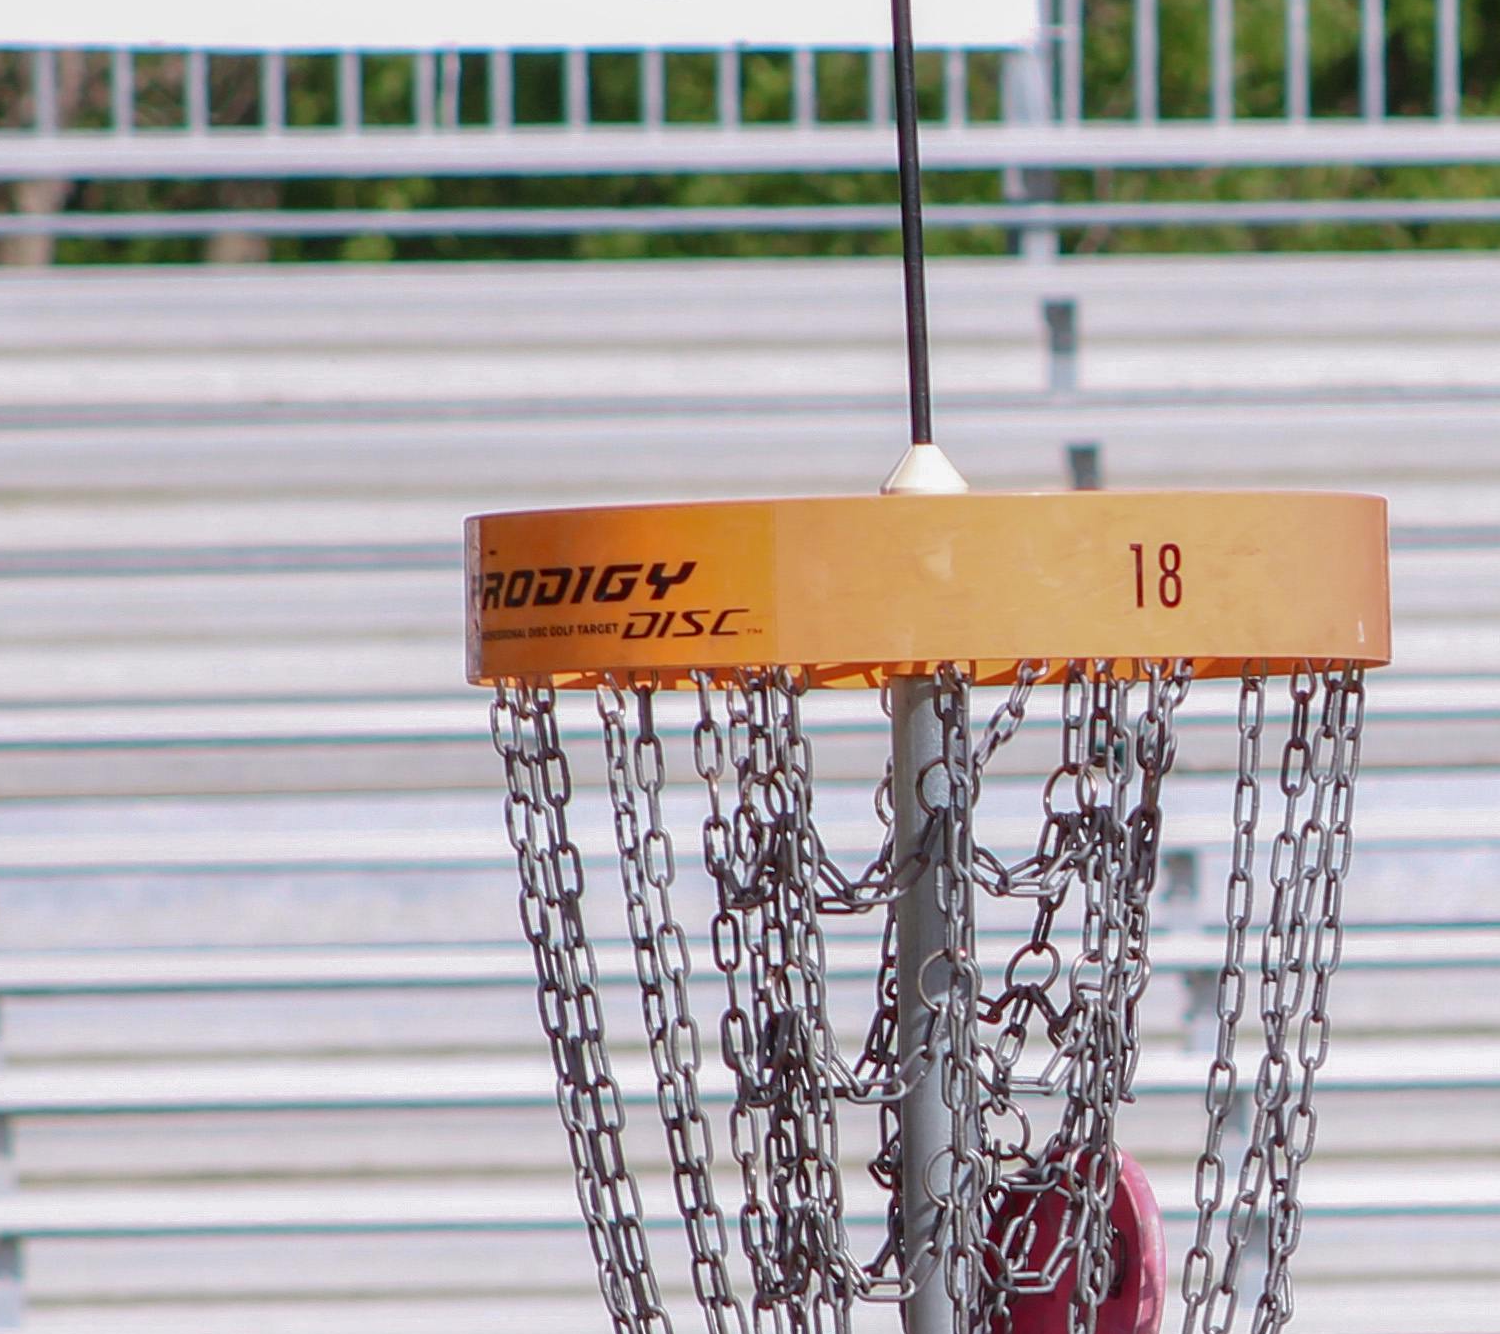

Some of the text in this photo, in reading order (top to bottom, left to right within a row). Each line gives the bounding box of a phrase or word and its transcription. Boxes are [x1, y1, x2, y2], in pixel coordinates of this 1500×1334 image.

[1129, 543, 1182, 608] 18
[577, 622, 619, 636] TARGET
[621, 608, 750, 640] DISC
